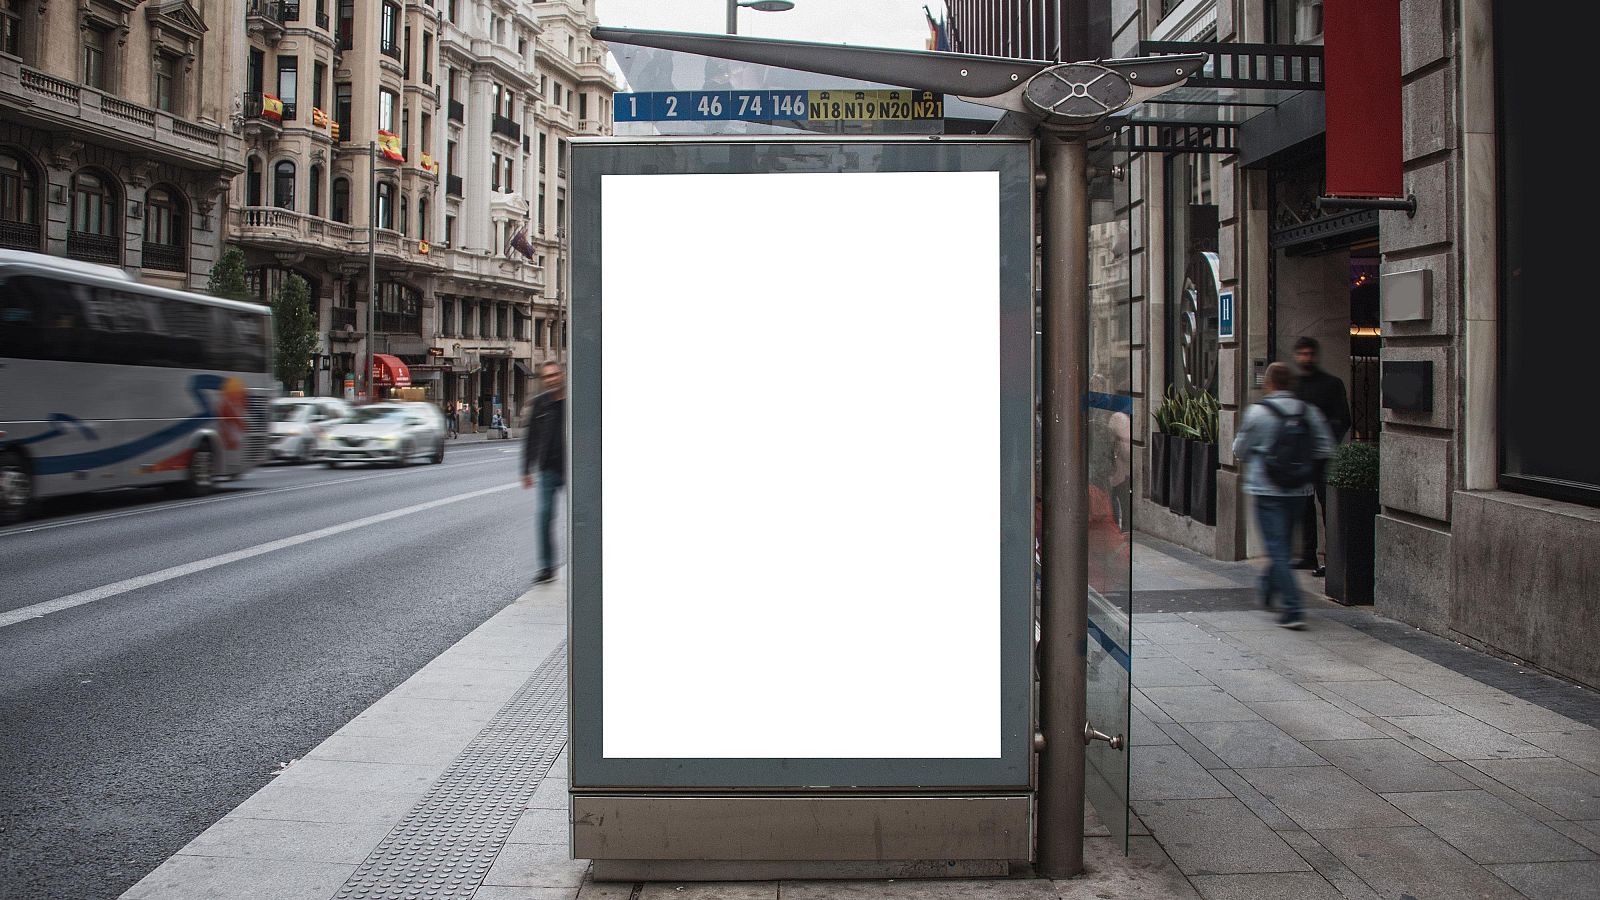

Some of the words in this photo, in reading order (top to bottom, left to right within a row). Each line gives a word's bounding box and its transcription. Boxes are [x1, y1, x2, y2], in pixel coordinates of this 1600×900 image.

[629, 96, 637, 117] 1
[666, 96, 677, 117] 2
[697, 95, 722, 116] 46
[738, 95, 762, 116] 74
[772, 95, 805, 116] 146
[810, 102, 841, 118] N18
[845, 102, 876, 118] N19
[879, 102, 910, 118] N20
[914, 101, 942, 118] N21
